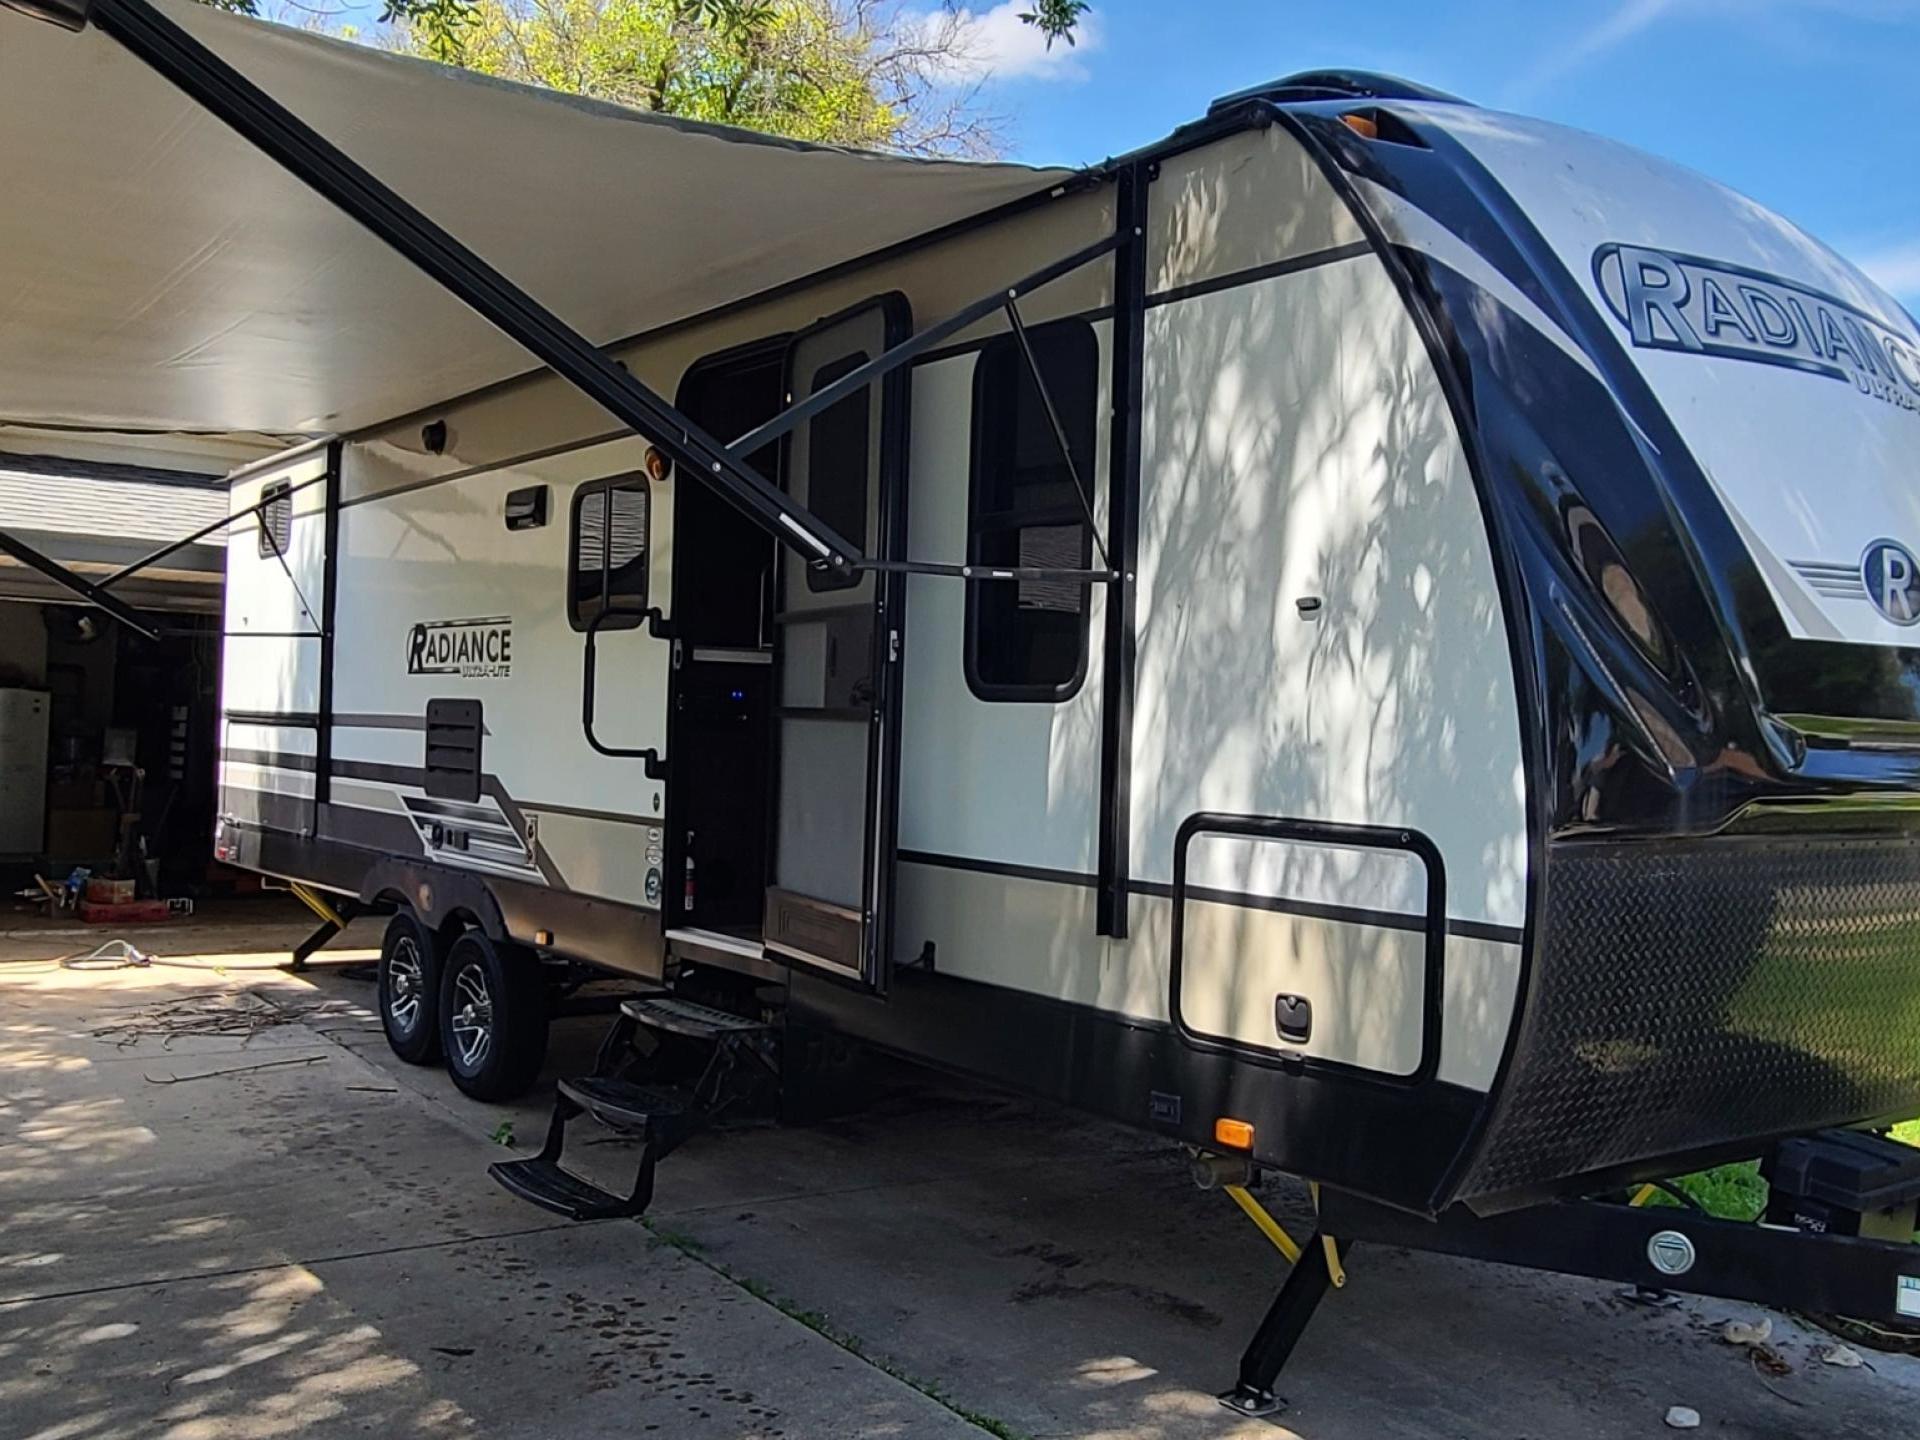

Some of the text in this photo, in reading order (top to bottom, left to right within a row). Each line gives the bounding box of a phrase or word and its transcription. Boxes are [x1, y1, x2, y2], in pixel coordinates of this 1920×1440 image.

[1619, 247, 1920, 396] RADIANC
[1882, 548, 1912, 619] R
[408, 623, 512, 674] RADIANCE
